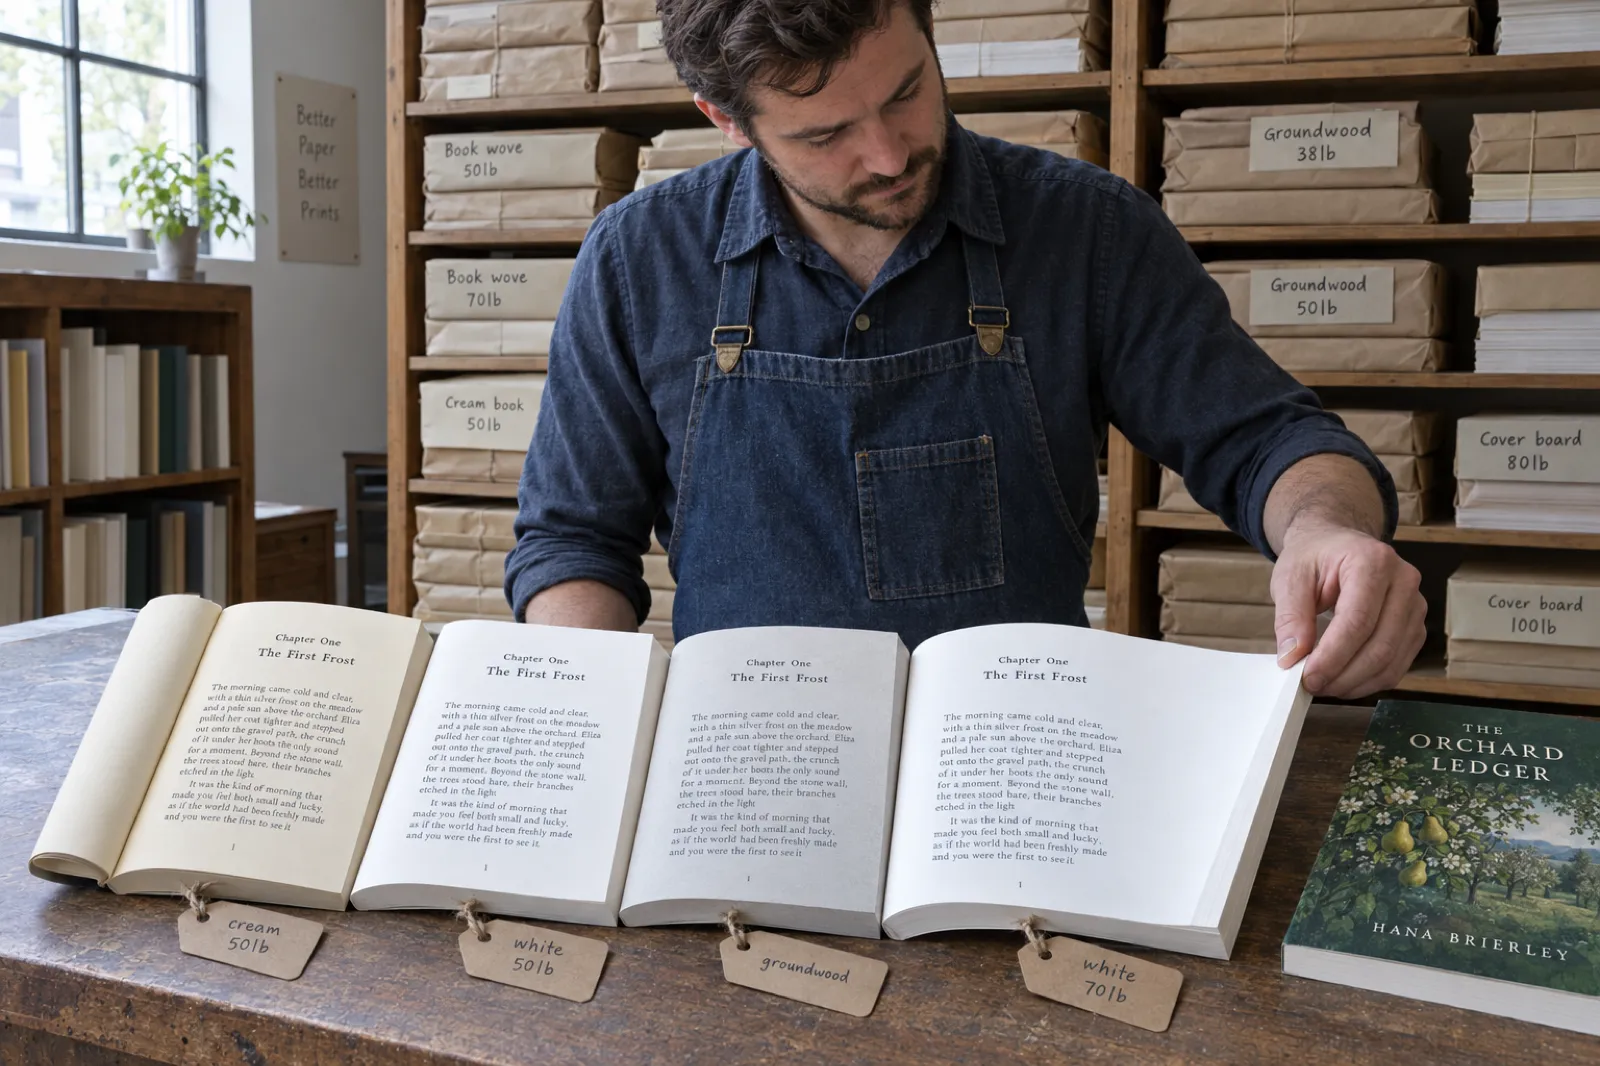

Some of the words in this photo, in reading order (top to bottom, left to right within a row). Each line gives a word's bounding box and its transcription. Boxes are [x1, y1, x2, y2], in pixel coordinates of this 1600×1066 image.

[297, 104, 336, 128] Better
[1264, 118, 1371, 141] Groundwood
[299, 135, 336, 162] Paper
[446, 140, 478, 158] Book
[487, 143, 523, 155] wove
[1298, 145, 1335, 161] 38lb
[464, 162, 497, 178] 50lb
[299, 168, 339, 190] Better
[301, 200, 339, 222] Prints
[448, 269, 482, 284] Book
[492, 271, 527, 283] wove
[1271, 275, 1366, 291] Groundwood
[467, 293, 501, 307] 70lb
[1298, 299, 1337, 315] 50lb
[446, 396, 486, 409] Cream
[494, 396, 524, 411] book
[468, 418, 500, 431] 50lb
[1480, 431, 1525, 446] Cover
[1536, 430, 1582, 446] board
[1508, 455, 1549, 470] 80lb
[1488, 594, 1530, 610] Cover
[1540, 595, 1583, 612] board
[1511, 617, 1556, 634] 100lb
[275, 634, 315, 645] Chapter
[320, 637, 341, 647] One
[258, 648, 281, 657] The
[287, 649, 316, 660] First
[322, 653, 355, 665] Frost
[503, 654, 543, 664] Chapter
[548, 656, 569, 664] One
[746, 659, 785, 668] Chapter
[998, 656, 1040, 666] Chapter
[1047, 657, 1068, 665] One
[487, 666, 510, 676] The
[517, 668, 546, 679] First
[553, 671, 585, 681] Frost
[731, 672, 754, 682] The
[761, 673, 789, 682] First
[797, 674, 828, 683] Frost
[983, 670, 1008, 679] The
[1015, 670, 1045, 680] First
[1052, 672, 1087, 683] Frost
[464, 703, 501, 712] morning
[944, 713, 962, 721] The
[965, 711, 1004, 721] morning
[1007, 713, 1031, 721] came
[1034, 714, 1054, 723] cold
[1057, 717, 1075, 726] and
[943, 724, 963, 732] with
[973, 722, 992, 730] thin
[994, 722, 1020, 731] silver
[1021, 723, 1045, 733] frost
[1062, 728, 1077, 737] the
[1080, 732, 1118, 741] meadow
[1462, 723, 1503, 735] THE
[686, 744, 713, 757] pulled
[716, 744, 730, 752] her
[753, 743, 784, 753] tighter
[785, 743, 802, 752] and
[805, 745, 839, 755] stepped
[940, 746, 968, 757] pulled
[970, 745, 986, 754] her
[1011, 745, 1044, 756] tighter
[1045, 749, 1063, 757] and
[1066, 752, 1103, 763] stepped
[1409, 733, 1564, 760] ORCHARD
[1432, 756, 1550, 782] LEDGER
[459, 800, 474, 808] the
[476, 801, 495, 809] kind
[509, 805, 547, 816] morning
[550, 807, 567, 815] that
[412, 809, 437, 818] made
[438, 812, 455, 820] you
[458, 811, 475, 820] feel
[476, 812, 497, 821] both
[498, 814, 522, 823] small
[524, 816, 540, 825] and
[690, 813, 698, 822] It
[720, 812, 735, 821] the
[737, 812, 757, 821] kind
[759, 813, 770, 821] of
[772, 814, 809, 825] morning
[812, 815, 830, 824] that
[950, 817, 958, 825] It
[980, 815, 996, 824] the
[998, 815, 1019, 825] kind
[1022, 817, 1032, 825] of
[1035, 820, 1076, 832] morning
[1079, 823, 1098, 832] that
[934, 829, 958, 838] made
[961, 830, 978, 838] you
[981, 827, 997, 836] feel
[1000, 827, 1022, 836] both
[1025, 829, 1049, 838] small
[1052, 831, 1069, 840] and
[945, 839, 954, 849] if
[955, 840, 970, 848] the
[973, 839, 1000, 848] world
[1003, 839, 1021, 848] had
[1023, 839, 1045, 850] been
[1047, 841, 1079, 855] freshly
[1082, 848, 1107, 856] made
[932, 852, 949, 861] and
[952, 854, 969, 862] you
[997, 851, 1012, 859] the
[1015, 852, 1034, 860] first
[228, 918, 281, 936] cream
[228, 936, 270, 954] 50lb
[514, 937, 564, 956] white
[1373, 922, 1432, 940] HANA
[1450, 932, 1569, 961] BRIERLEY
[512, 957, 554, 976] 50lb
[760, 956, 850, 984] groundwood
[1083, 957, 1136, 982] white
[1085, 979, 1127, 1003] 70lb
